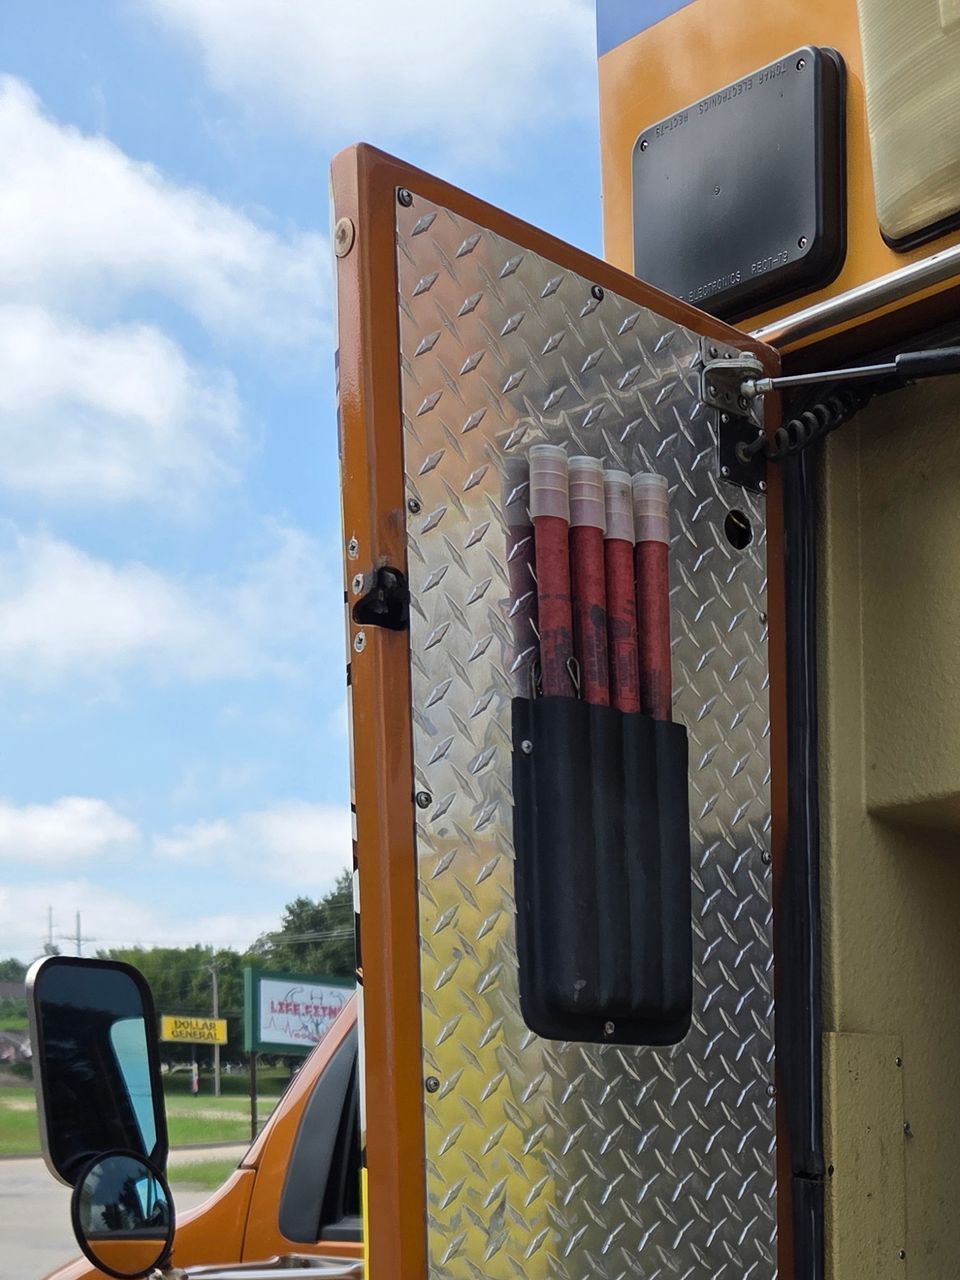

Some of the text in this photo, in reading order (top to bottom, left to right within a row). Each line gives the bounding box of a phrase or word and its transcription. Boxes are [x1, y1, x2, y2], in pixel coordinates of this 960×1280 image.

[759, 63, 787, 86] TOMAR
[698, 79, 753, 115] ELECTRONICS
[688, 270, 741, 302] ELECTRONICS
[270, 1000, 300, 1015] LIFE
[174, 1019, 217, 1031] DOLLAR
[171, 1030, 220, 1041] GENERAL
